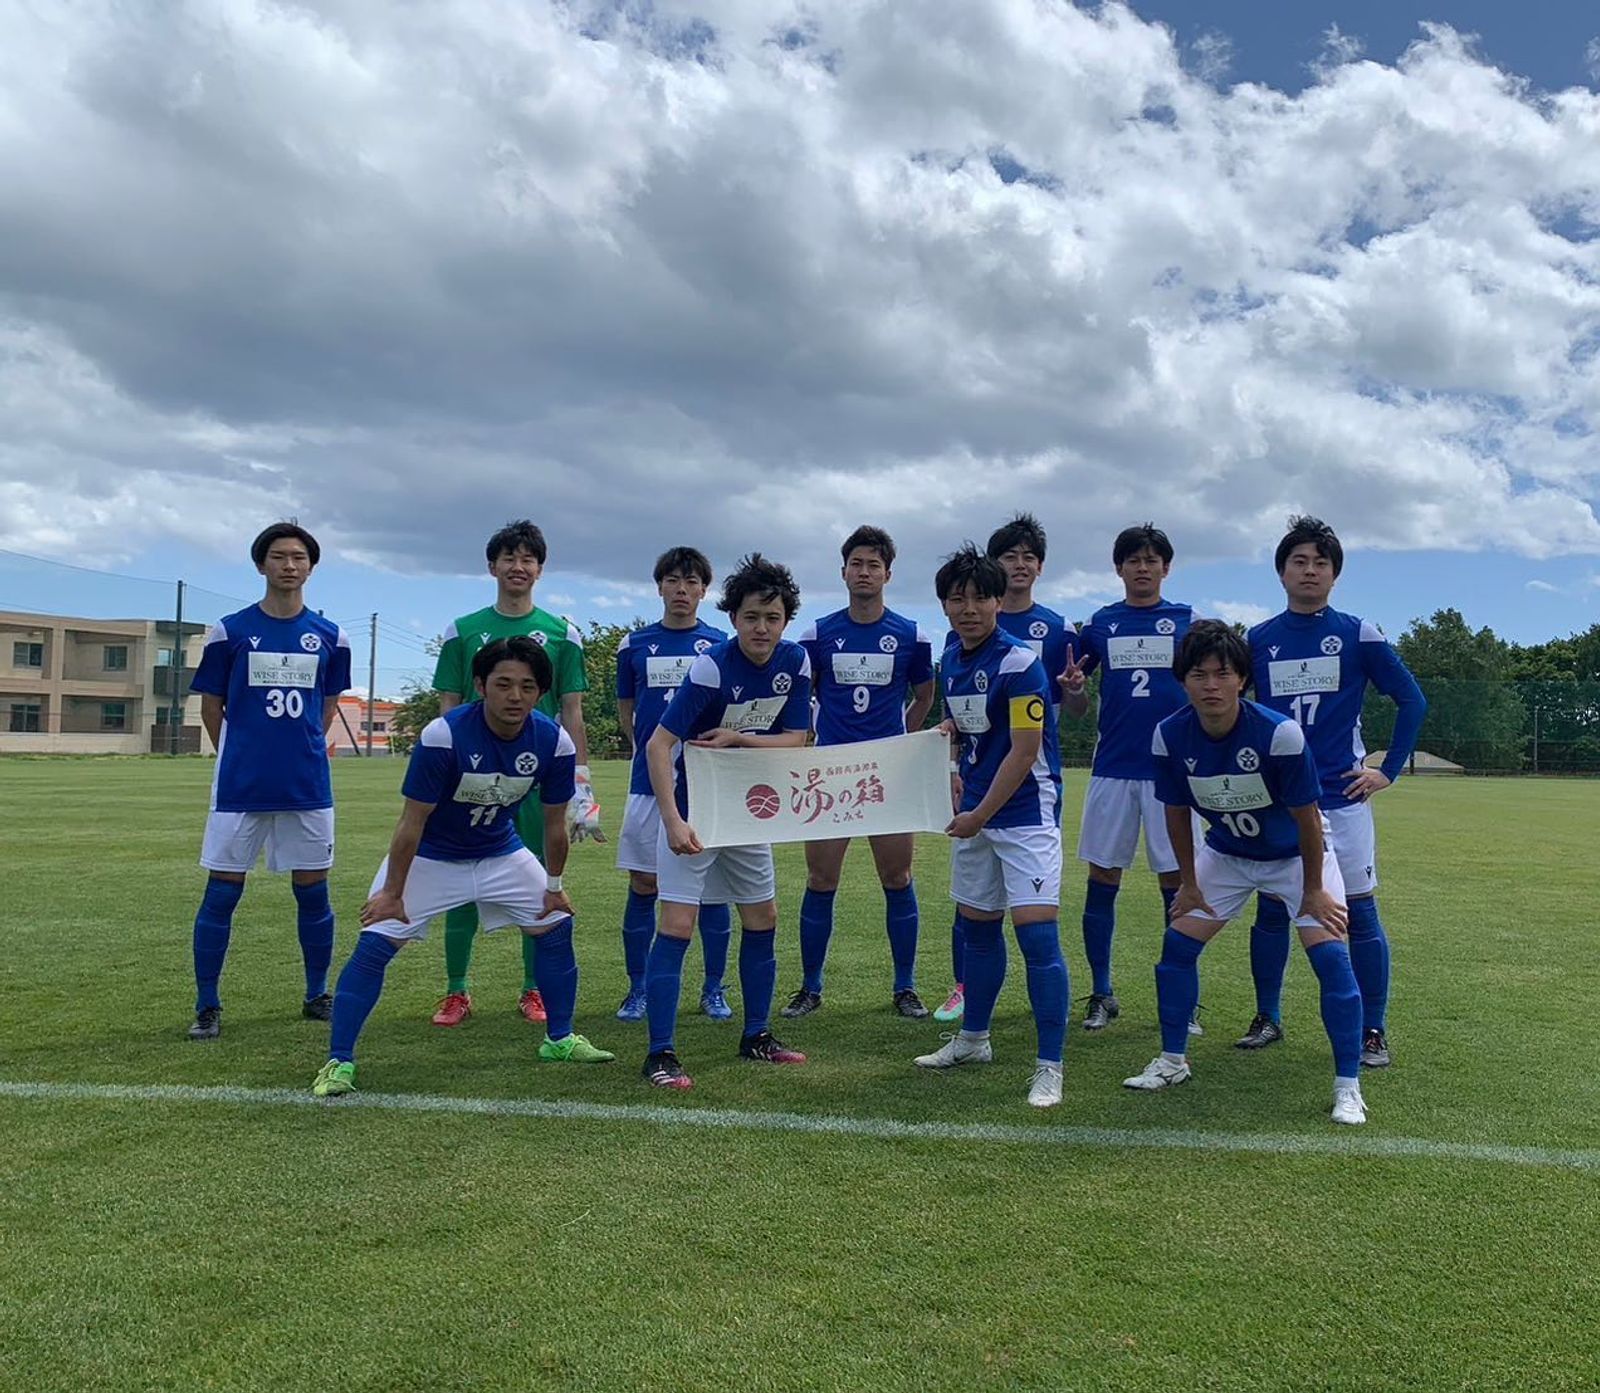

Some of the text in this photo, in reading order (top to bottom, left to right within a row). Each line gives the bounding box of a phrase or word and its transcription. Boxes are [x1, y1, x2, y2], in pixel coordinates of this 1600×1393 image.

[253, 671, 313, 682] WISE STORY
[1131, 669, 1150, 697] 2
[1273, 679, 1299, 689] WISE
[1301, 675, 1336, 687] STORY
[266, 689, 303, 718] 30
[853, 686, 870, 713] 9
[1290, 694, 1320, 726] 17
[789, 768, 885, 825] 湯の箱
[1226, 793, 1263, 806] STORY
[469, 805, 500, 827] 11
[832, 810, 864, 824] こみち
[1221, 812, 1260, 838] 10
